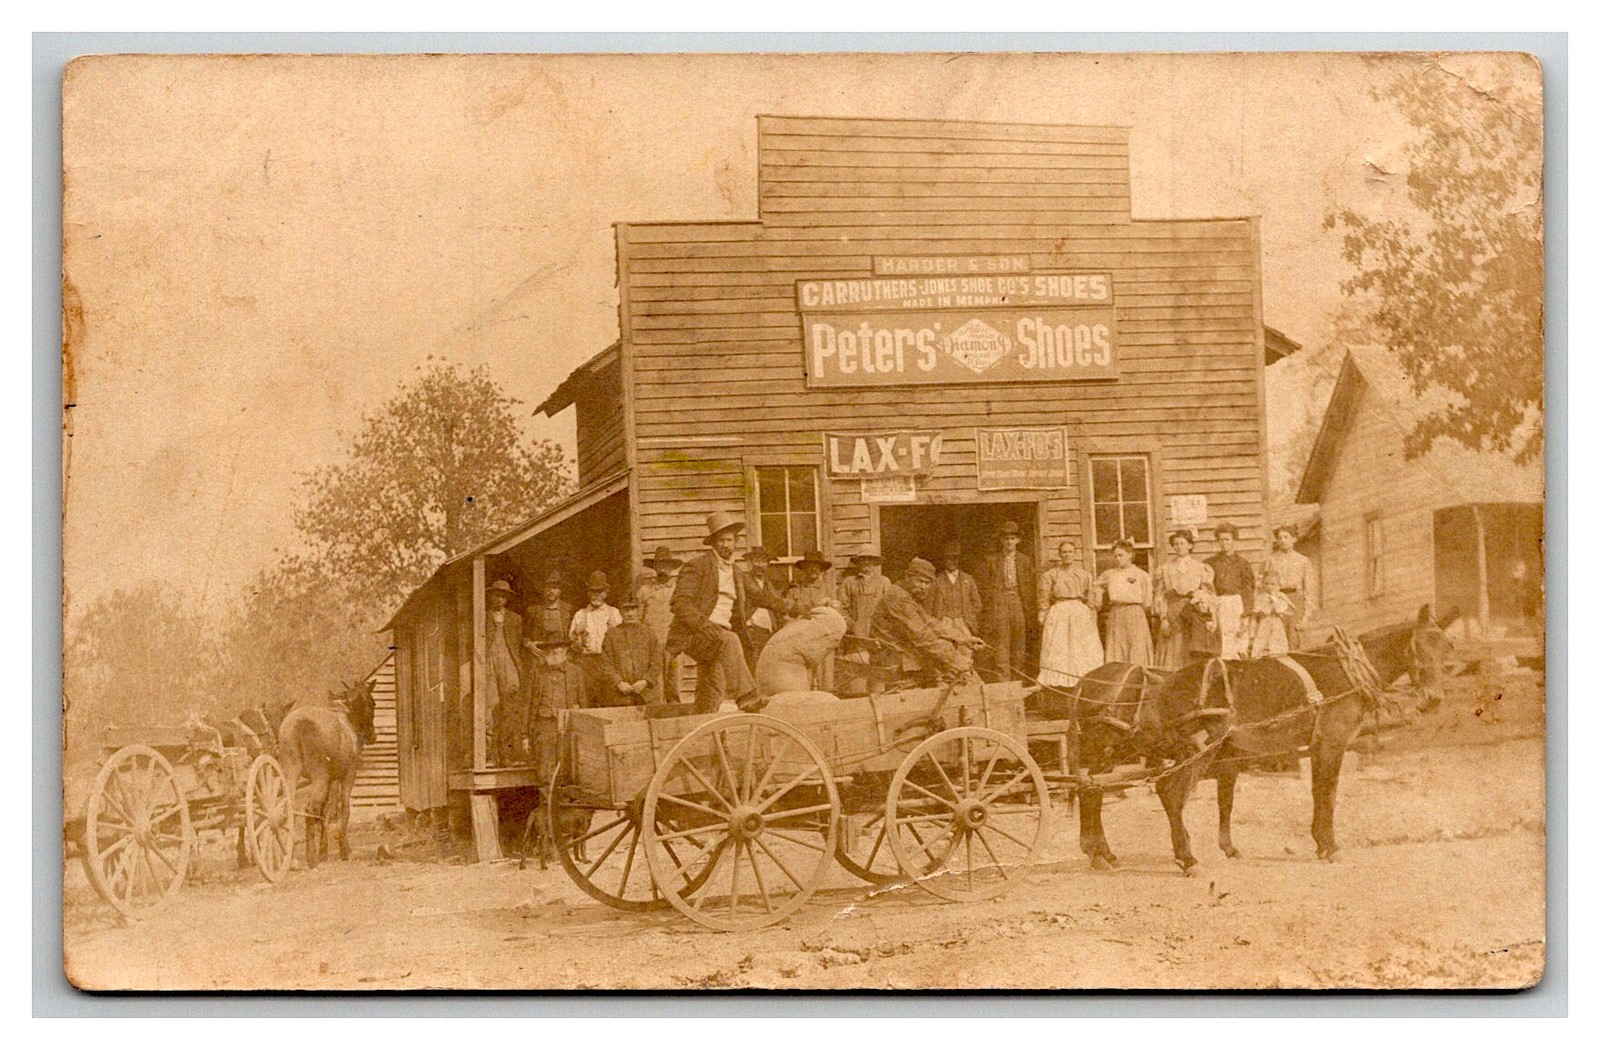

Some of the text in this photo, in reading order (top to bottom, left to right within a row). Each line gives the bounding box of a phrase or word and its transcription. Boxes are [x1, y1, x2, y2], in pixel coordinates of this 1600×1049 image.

[882, 257, 1025, 273] HARDER & SON
[961, 277, 993, 294] SHOE
[1034, 275, 1108, 299] SHOES
[903, 298, 933, 308] MADE
[938, 296, 951, 307] IN
[811, 322, 942, 378] Peters'
[1017, 317, 1111, 369] Shoes
